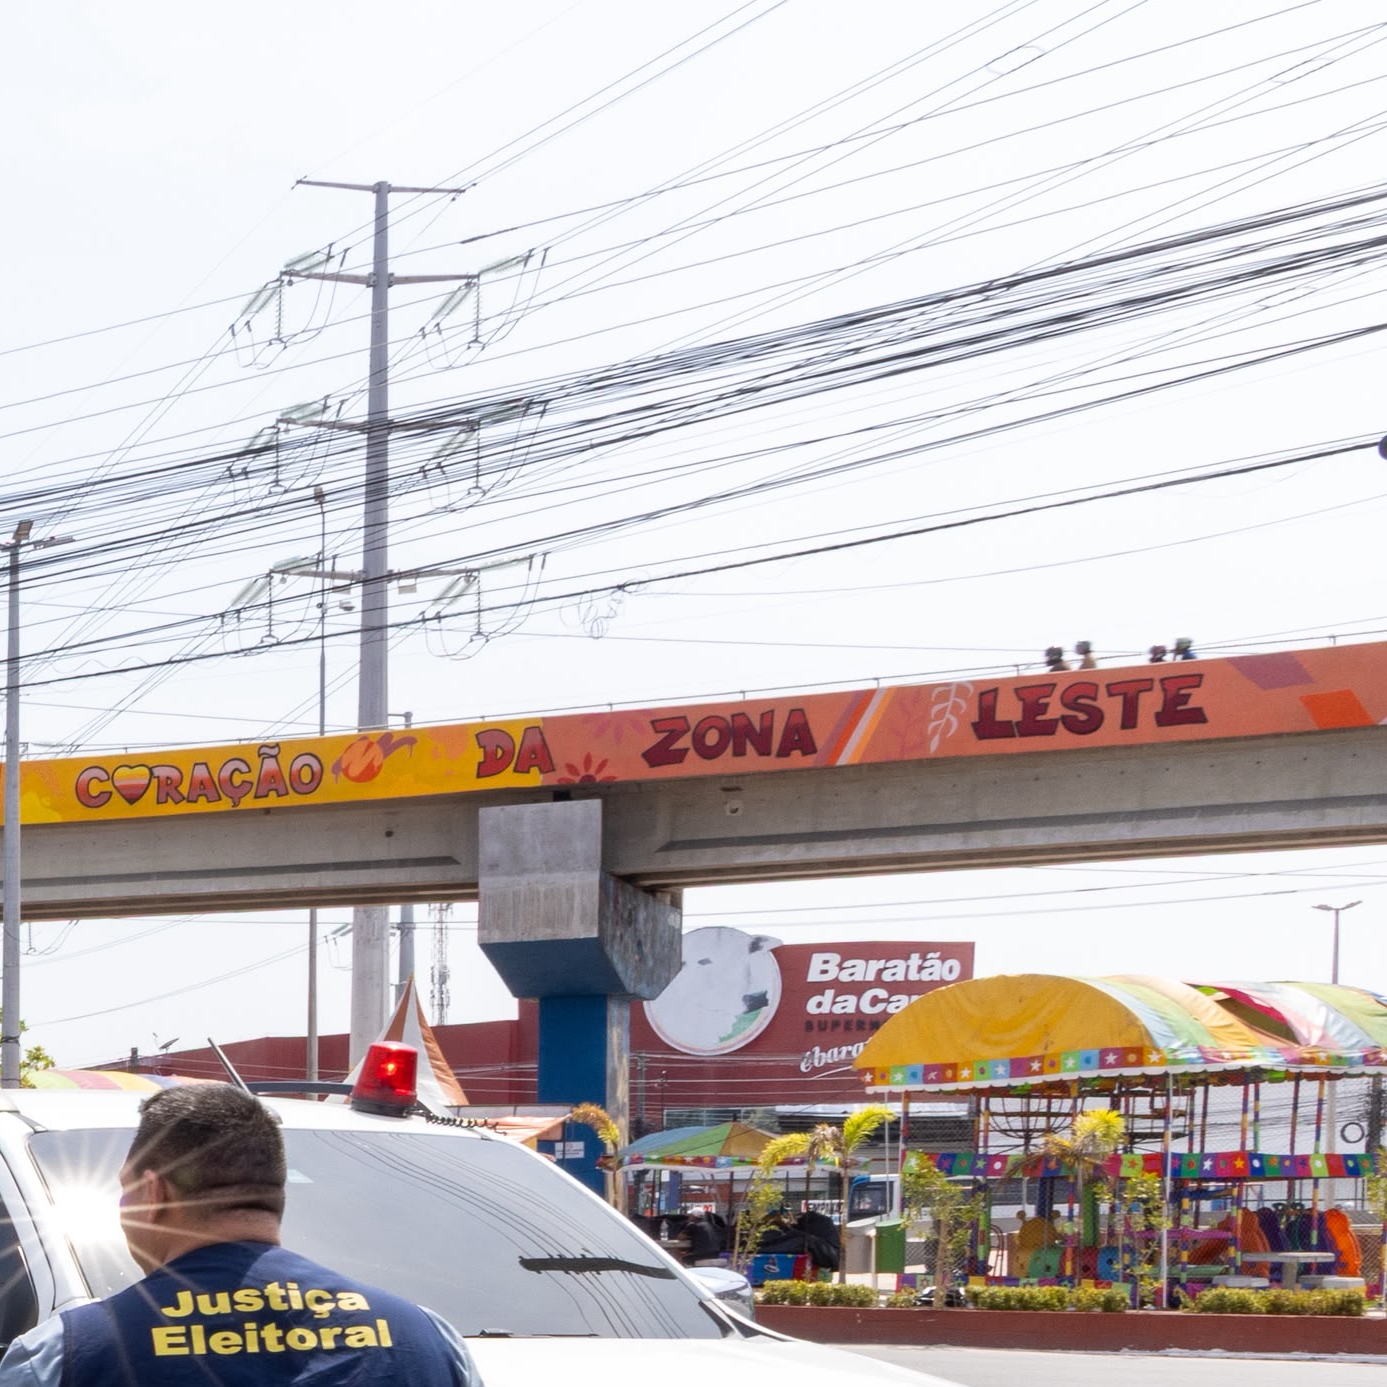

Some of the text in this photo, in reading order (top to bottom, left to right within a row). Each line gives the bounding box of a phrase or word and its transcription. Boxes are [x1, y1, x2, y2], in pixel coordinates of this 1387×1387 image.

[476, 726, 555, 779] DA
[641, 707, 817, 768] ZONA
[971, 673, 1209, 741] LESTE
[806, 951, 961, 983] Baratão
[161, 1281, 370, 1319] Justiça
[151, 1318, 393, 1356] Eleitoral
